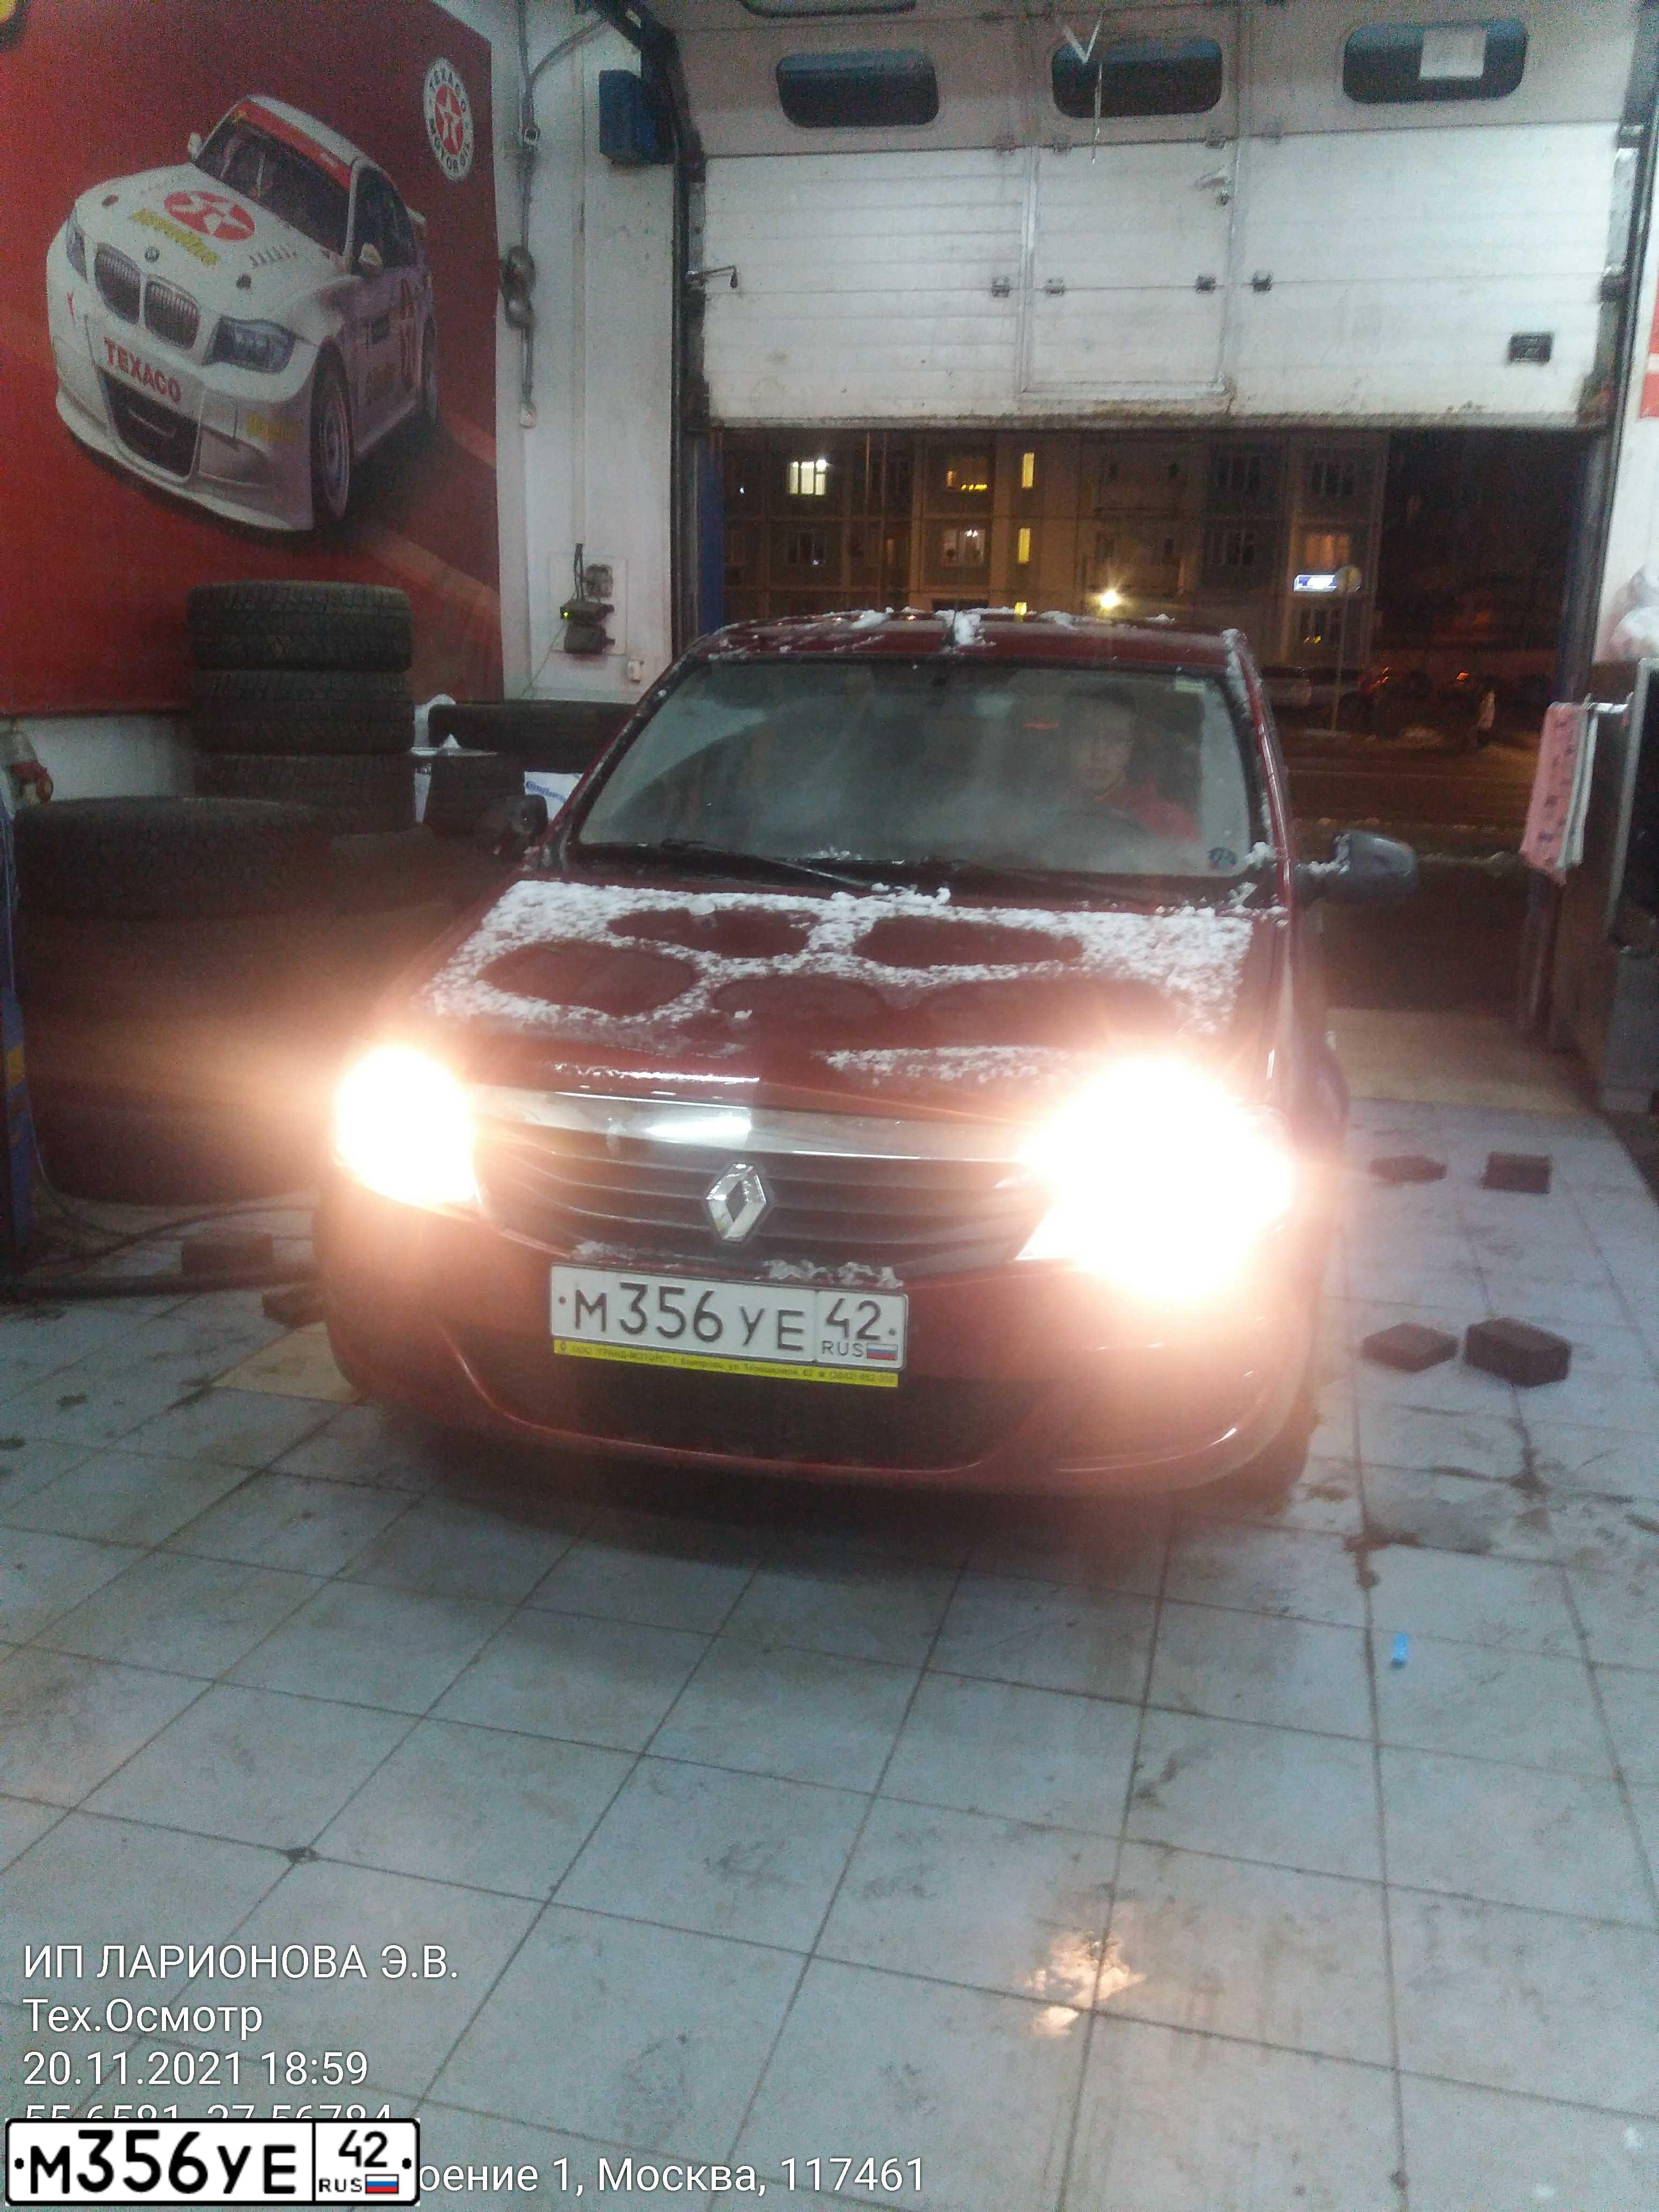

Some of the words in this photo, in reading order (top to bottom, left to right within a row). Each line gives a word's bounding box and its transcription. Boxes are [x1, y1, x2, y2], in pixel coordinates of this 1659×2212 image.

[104, 336, 182, 403] TEXACO
[826, 1297, 881, 1341] 42
[822, 1340, 864, 1358] RUS
